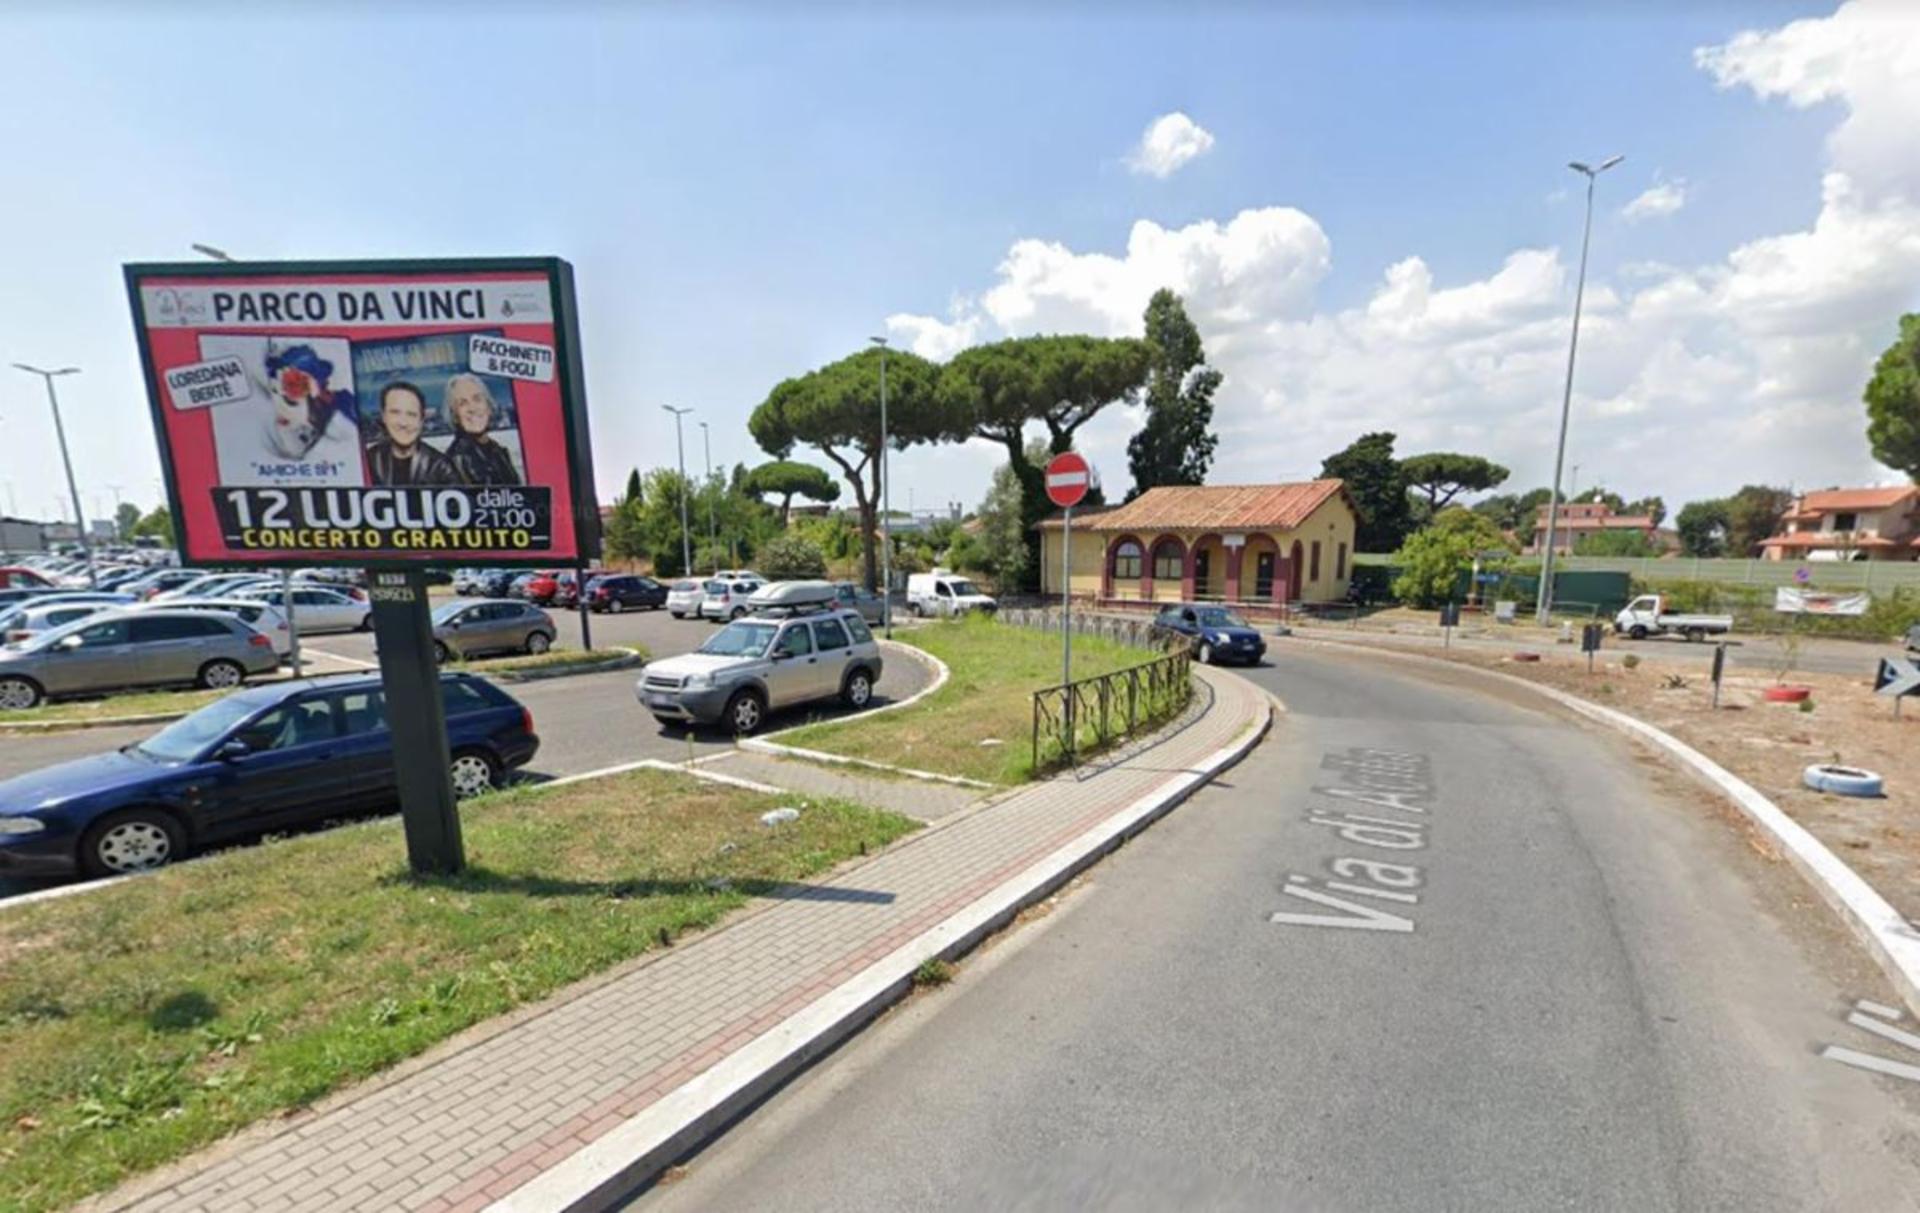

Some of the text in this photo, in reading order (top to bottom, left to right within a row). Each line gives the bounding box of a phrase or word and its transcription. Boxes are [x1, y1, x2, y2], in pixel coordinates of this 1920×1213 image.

[213, 292, 327, 321] PARCO
[338, 291, 384, 320] DA
[392, 289, 485, 319] VINCI
[472, 338, 552, 363] FACCHINETTI
[169, 361, 242, 390] LOREDANA
[488, 358, 499, 371] &
[228, 490, 472, 528] 12 LUGLIO
[476, 488, 524, 508] dalle
[474, 508, 536, 528] 21:00
[243, 529, 531, 548] CONCERTO GRATUITO
